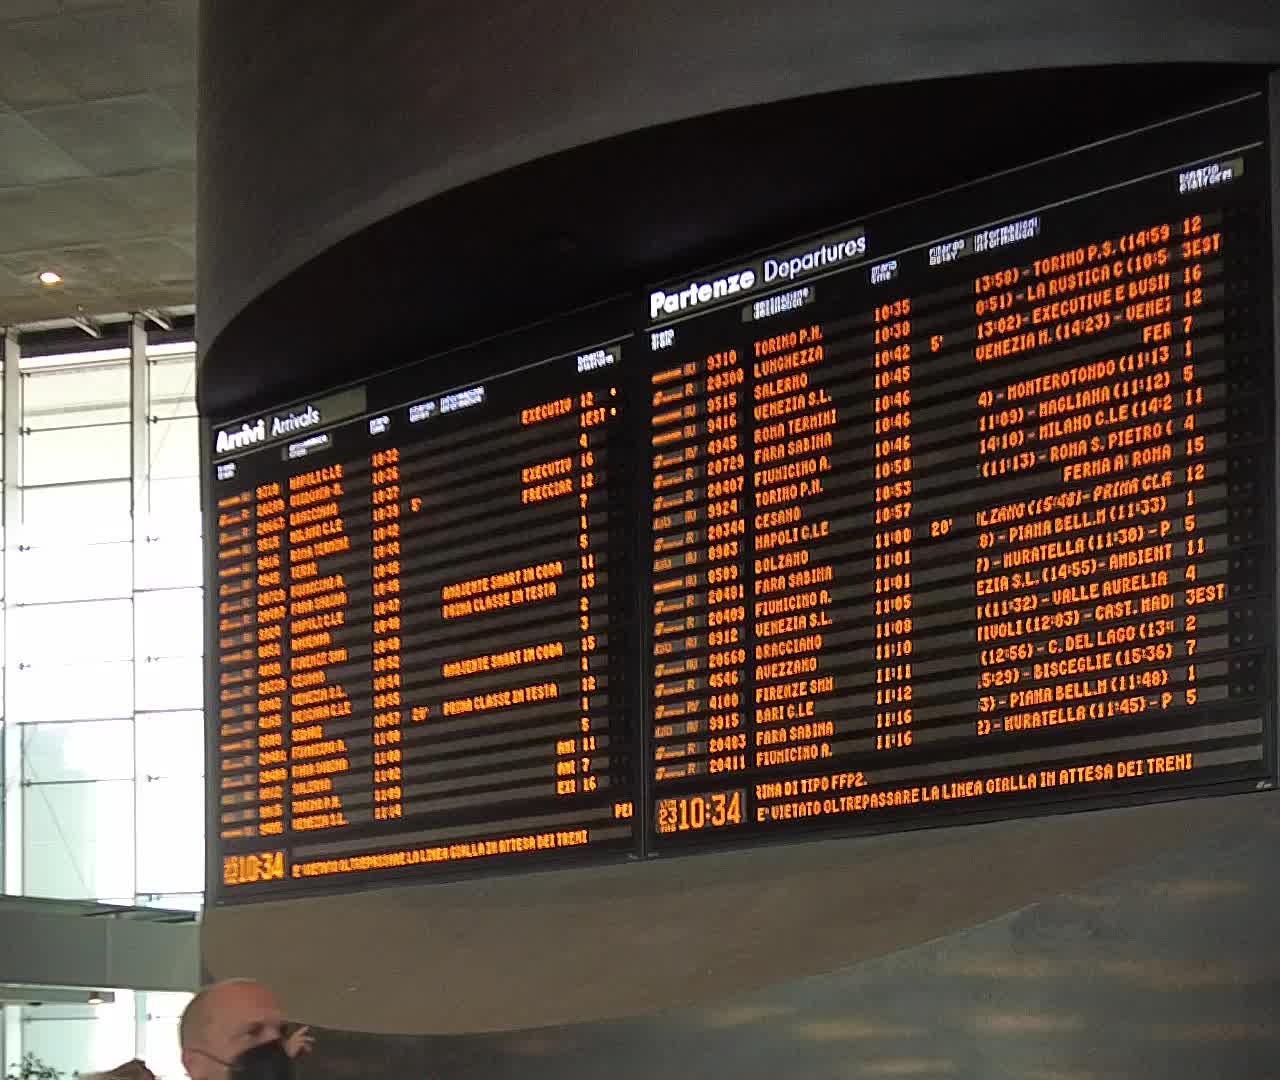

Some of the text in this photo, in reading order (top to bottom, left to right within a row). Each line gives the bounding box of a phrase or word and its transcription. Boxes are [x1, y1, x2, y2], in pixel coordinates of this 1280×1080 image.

[650, 269, 756, 319] Partenze
[763, 235, 867, 283] Departures
[753, 345, 823, 378] LUNGHEZZA
[1049, 264, 1111, 296] RUSTICA
[755, 331, 797, 357] TORINO
[1033, 248, 1085, 277] TORINO
[1183, 215, 1202, 236] 12
[753, 372, 808, 401] SALERNO
[1032, 287, 1112, 324] EXECUTIVE
[1183, 264, 1202, 285] 16
[753, 393, 806, 421] VENEZIA
[975, 332, 1036, 362] VENEZIA
[1184, 287, 1203, 308] 12
[753, 422, 785, 444] ROMA
[787, 408, 837, 435] TERMINI
[1183, 315, 1193, 334] 7
[216, 418, 265, 454] Arrivi
[271, 404, 321, 437] Arrivals
[753, 443, 785, 465] FARA
[787, 431, 833, 456] SABINA
[1007, 359, 1116, 401] MONTEROTONDO
[1185, 340, 1192, 358] 1
[754, 458, 817, 488] FIUMICINO
[1039, 385, 1111, 418] MAGLIANA
[1183, 364, 1194, 383] 5
[755, 484, 798, 508] TORINO
[1039, 413, 1092, 441] MILANO
[1185, 387, 1203, 407] 11
[754, 506, 802, 530] CESANO
[1050, 439, 1088, 463] ROMA
[1108, 422, 1163, 450] PIETRO
[1183, 414, 1194, 430] 4
[754, 549, 809, 575] BOLZANO
[1187, 463, 1205, 483] 12
[755, 527, 799, 551] NAPOLI
[1063, 457, 1112, 482] FERMA
[1131, 443, 1172, 468] ROMA
[1186, 435, 1205, 456] 15
[754, 575, 786, 595] FARA
[788, 565, 833, 589] SABINA
[1009, 519, 1053, 543] PIANA
[1187, 489, 1194, 506] 1
[755, 591, 818, 618] FIUMICINO
[1003, 537, 1086, 569] MURATELLA
[1184, 514, 1196, 532] 5
[755, 615, 807, 638] VENEZIA
[1187, 537, 1205, 556] 11
[1051, 583, 1100, 606] VALLE
[1101, 570, 1169, 597] AURELIA
[1185, 564, 1196, 581] 4
[755, 681, 808, 704] FIRENZE
[1065, 632, 1094, 652] DEL
[1185, 615, 1196, 632] 2
[755, 657, 817, 681] AVEZZANO
[755, 705, 785, 724] BARI
[1033, 651, 1113, 680] BISCEGLIE
[1185, 639, 1196, 656] 7
[755, 727, 787, 746] FARA
[789, 721, 834, 742] SABINA
[1009, 687, 1053, 709] PIANA
[1188, 664, 1196, 682] 1
[756, 744, 819, 767] FIUMICINO
[1004, 705, 1087, 732] MURATELLA
[1186, 687, 1197, 705] 5
[678, 791, 742, 831] 10:34
[770, 799, 822, 820] VIETATO
[823, 787, 920, 814] OLTREPASSARE
[921, 785, 940, 802] LA
[941, 779, 983, 800] LINEA
[985, 773, 1037, 794] GIALLA
[1040, 770, 1056, 788] IN
[1059, 763, 1114, 786] ATTESA
[1117, 759, 1144, 779] DEI
[1146, 753, 1192, 774] TRENI
[800, 776, 830, 794] TIPO
